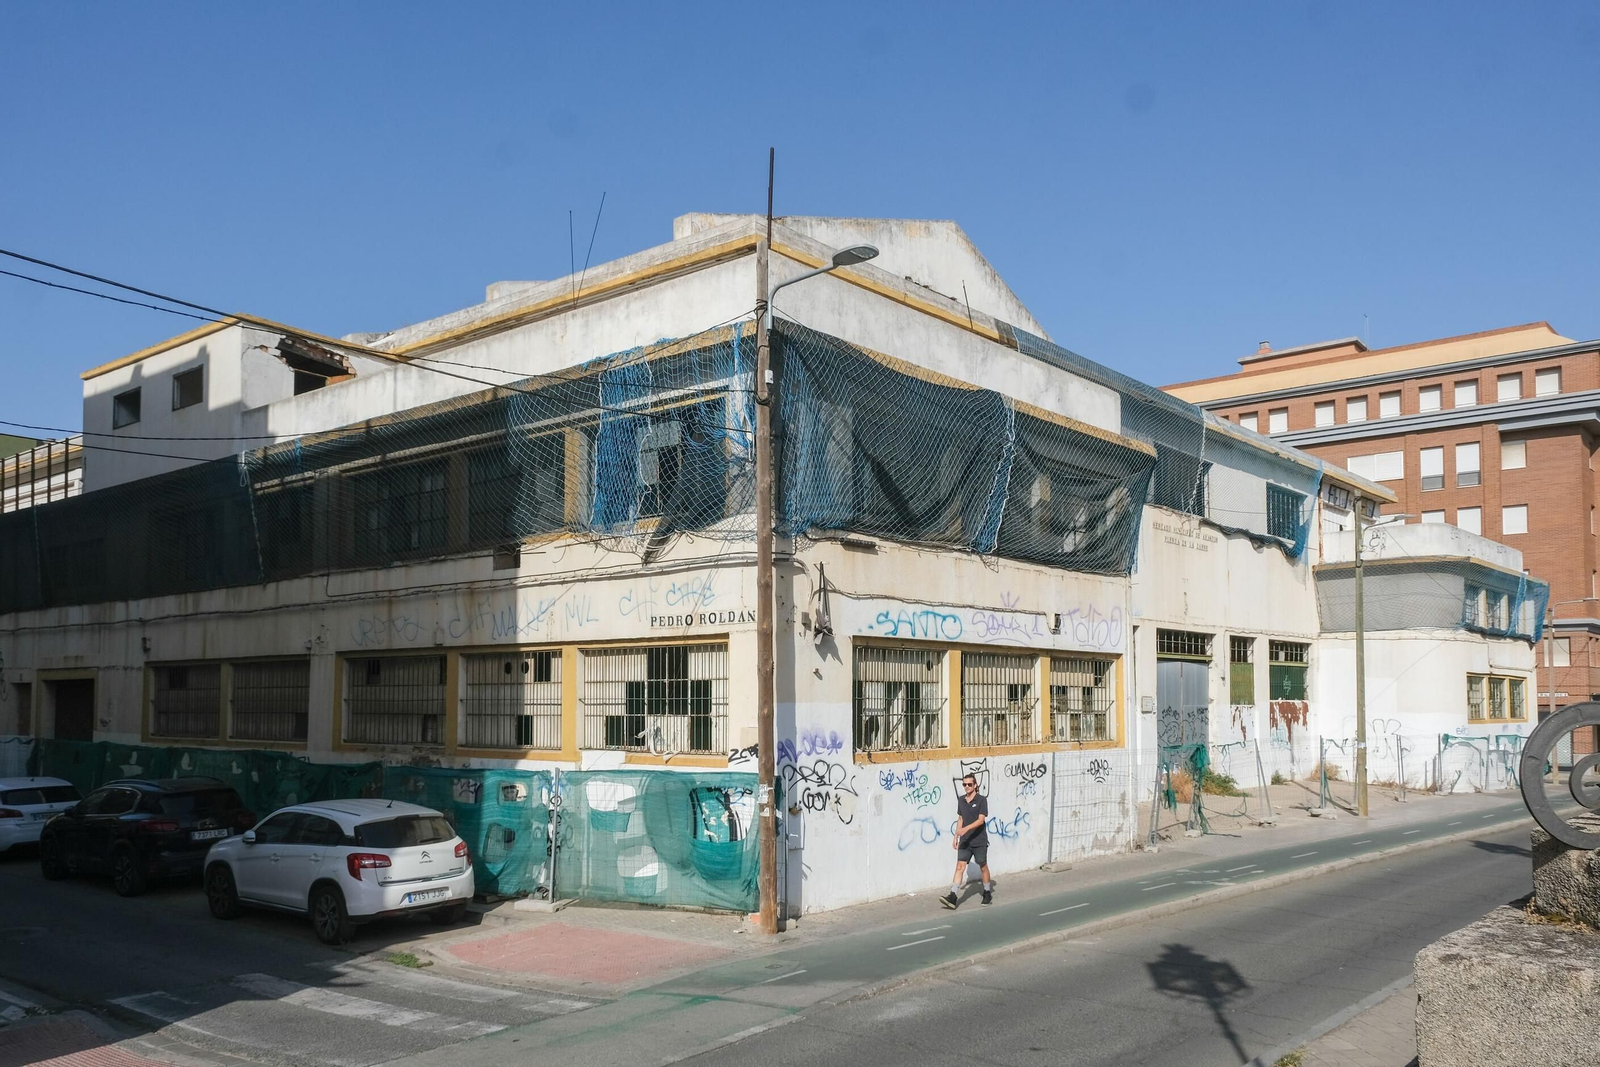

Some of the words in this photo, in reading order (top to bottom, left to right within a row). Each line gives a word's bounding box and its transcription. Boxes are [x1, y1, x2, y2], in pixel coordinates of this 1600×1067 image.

[650, 614, 694, 627] PEDRO
[699, 610, 756, 625] ROLDAN
[413, 892, 430, 901] 2151
